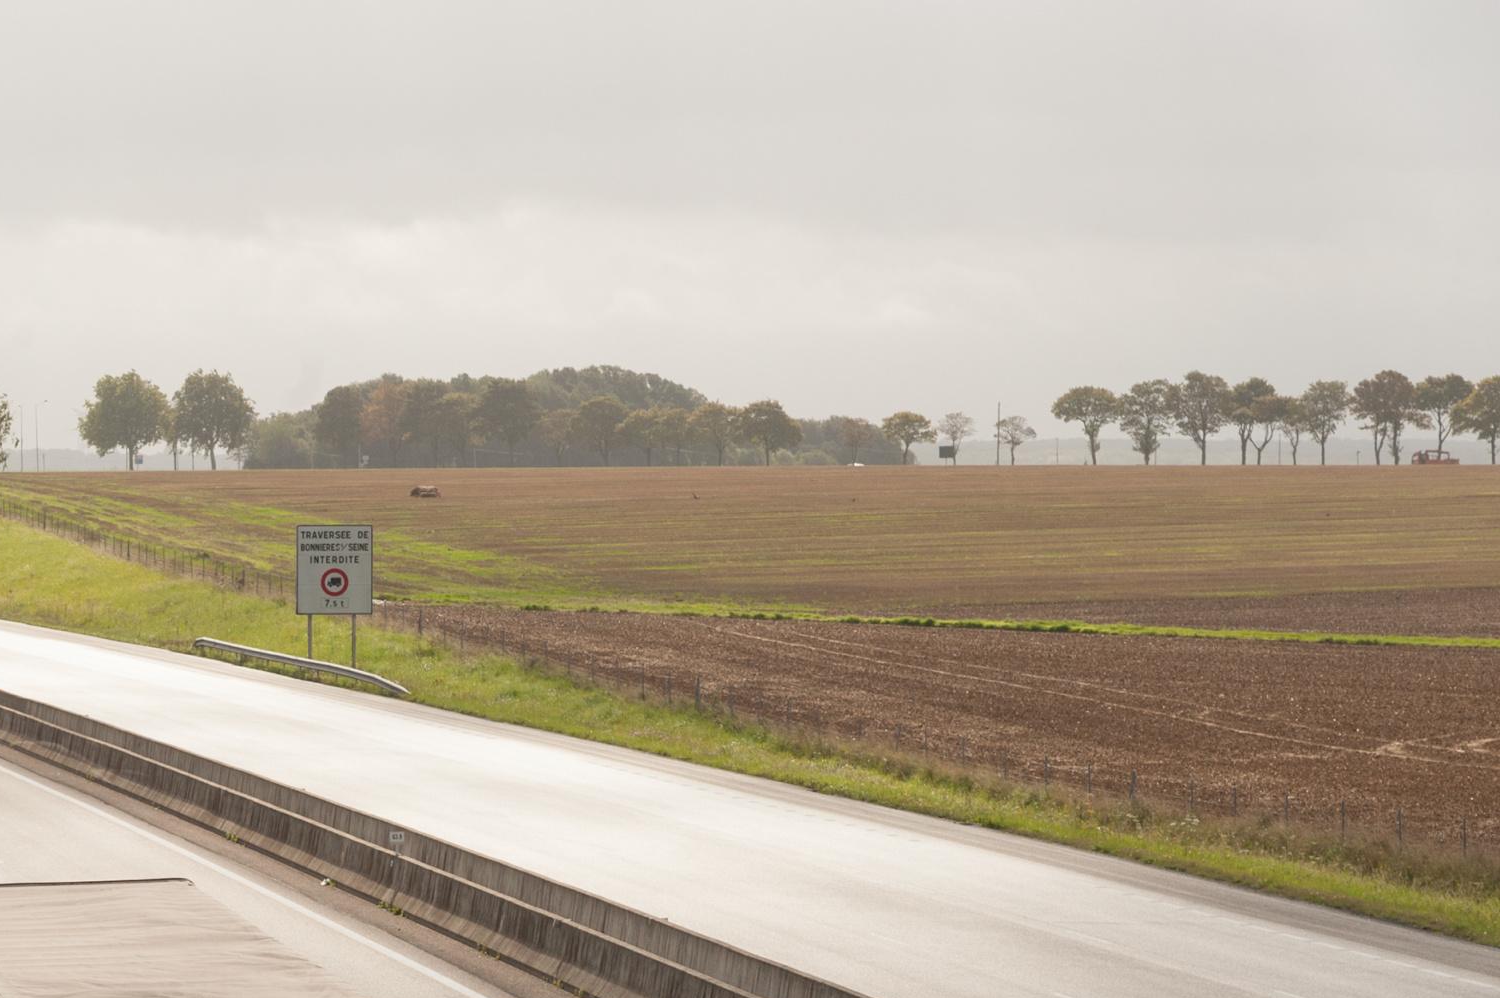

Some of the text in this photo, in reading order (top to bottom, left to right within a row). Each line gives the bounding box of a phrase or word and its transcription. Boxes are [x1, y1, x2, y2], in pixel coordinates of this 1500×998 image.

[300, 530, 369, 539] TRAVERSEE DE
[309, 555, 360, 564] INTERDITE
